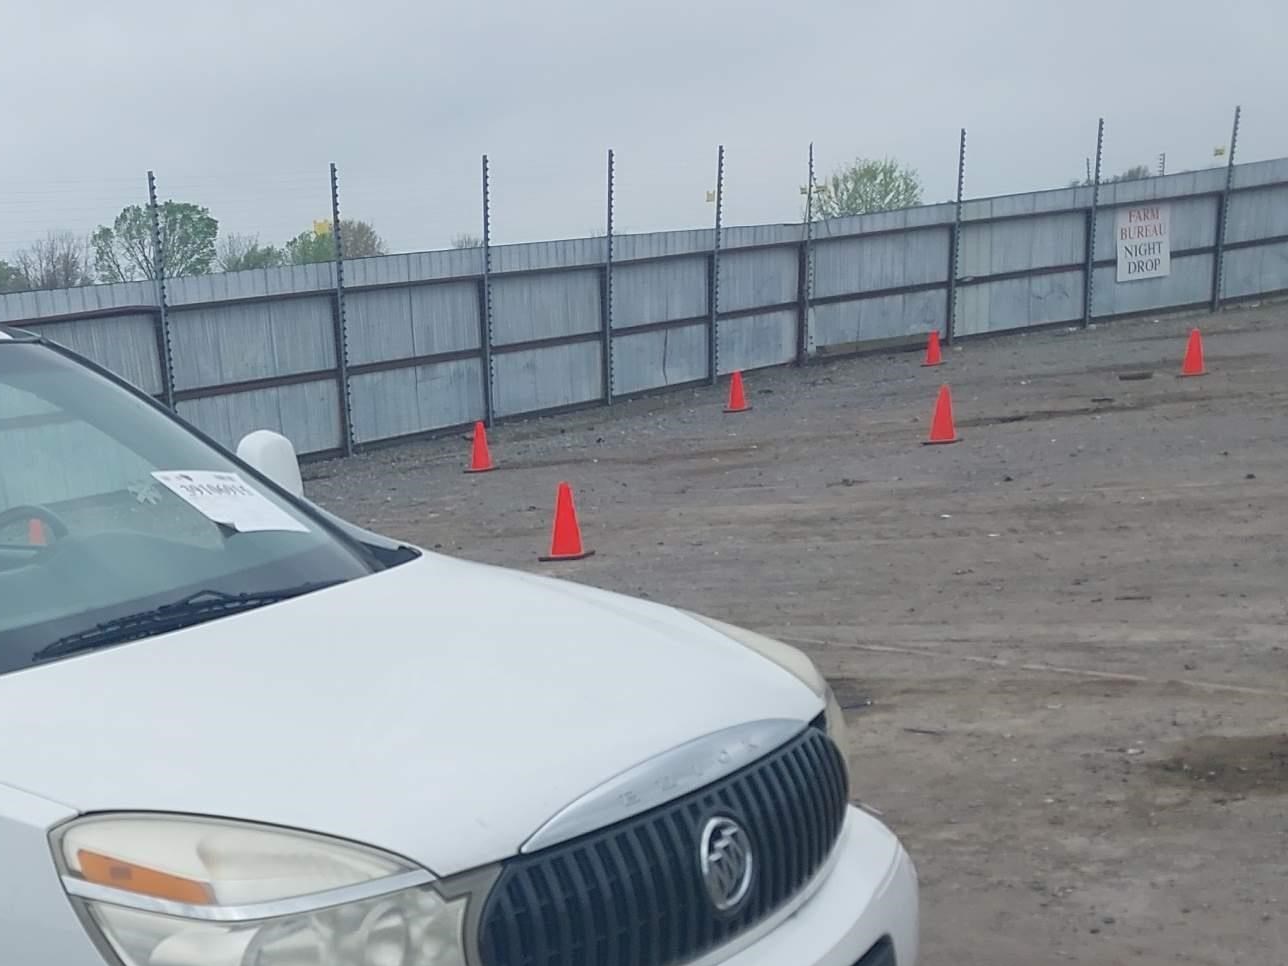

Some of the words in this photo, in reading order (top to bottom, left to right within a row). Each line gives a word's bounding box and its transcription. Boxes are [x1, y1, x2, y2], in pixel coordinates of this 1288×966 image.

[1128, 207, 1160, 223] FARM
[1120, 223, 1166, 240] BUREAU
[1124, 241, 1163, 258] NIGHT
[1128, 258, 1161, 274] DROP
